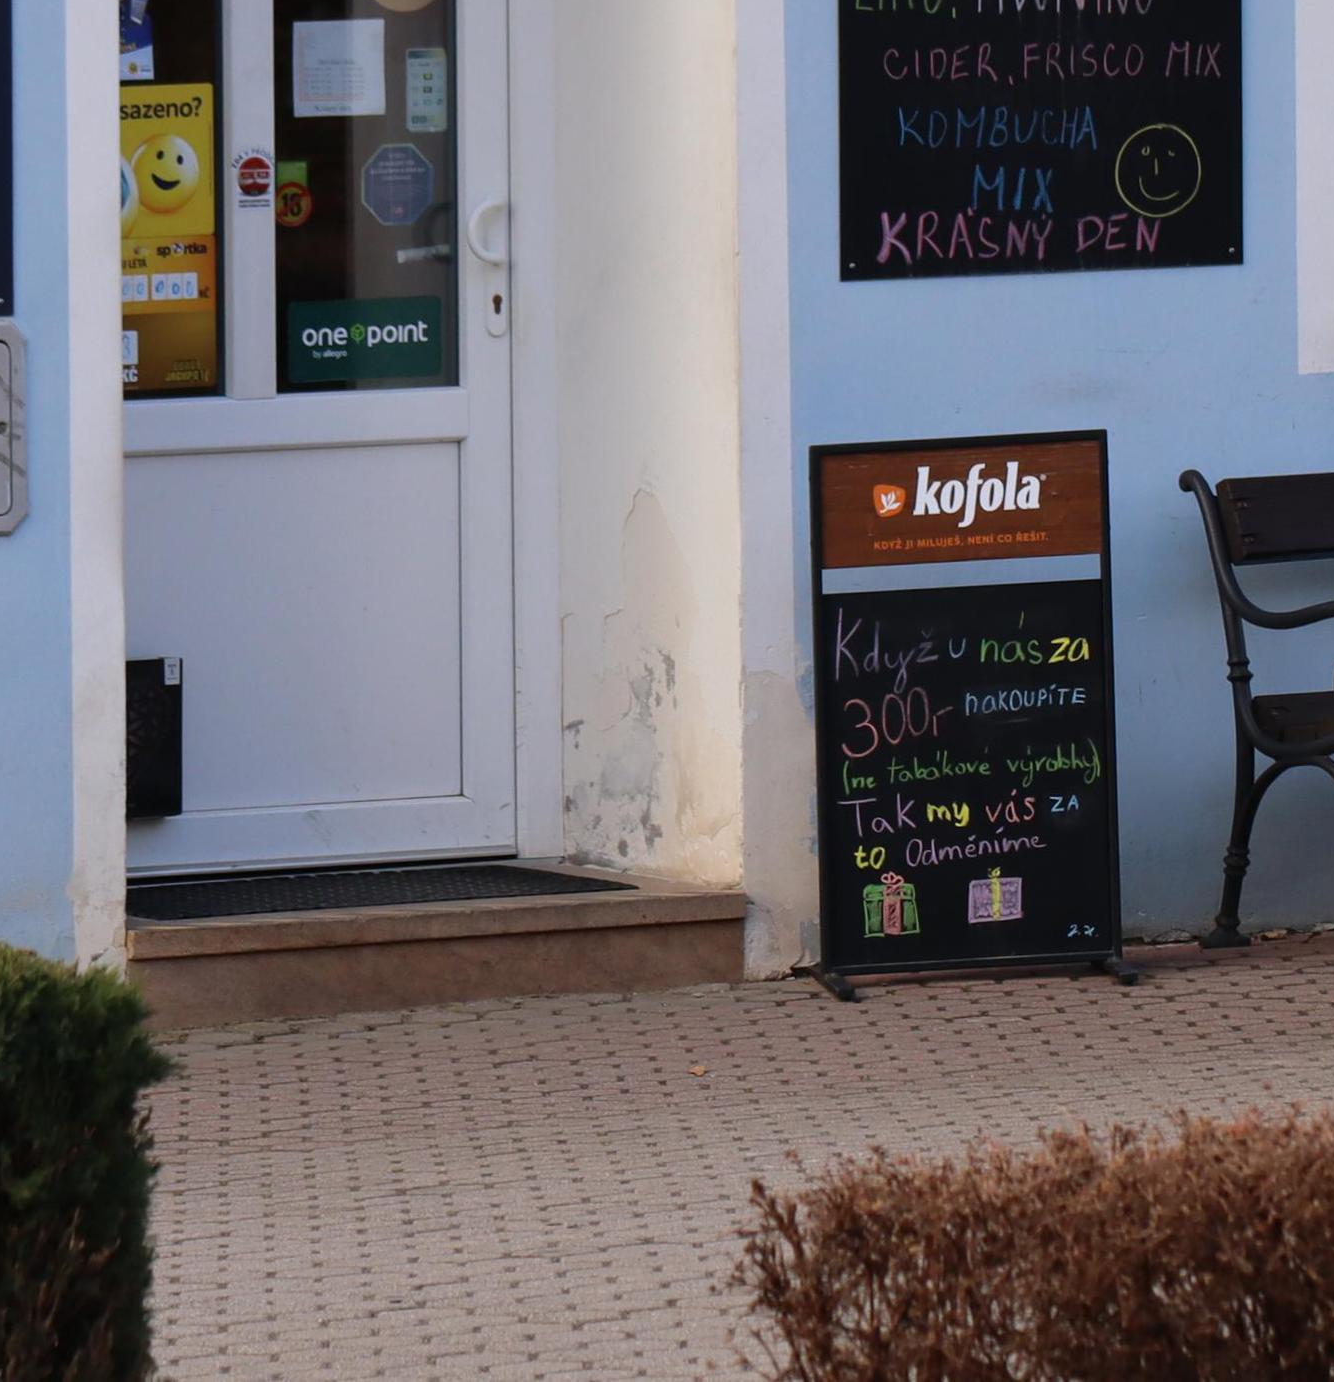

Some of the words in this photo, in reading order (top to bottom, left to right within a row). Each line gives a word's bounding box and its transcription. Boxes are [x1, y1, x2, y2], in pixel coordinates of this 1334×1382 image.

[1022, 42, 1144, 80] FRISCO
[1165, 41, 1222, 78] MIX
[898, 106, 1097, 150] KOMBUCHA
[971, 164, 1053, 212] MIX
[876, 207, 1052, 265] KRÁSNÝ
[1076, 213, 1161, 252] DEN
[302, 328, 347, 347] one
[367, 321, 428, 347] point
[913, 461, 1040, 528] kofola
[874, 538, 903, 551] KDYŽ
[905, 538, 914, 550] JI
[967, 533, 994, 546] NENÍ
[997, 534, 1013, 543] CO
[834, 608, 938, 692] Když
[979, 612, 1043, 665] nás
[1047, 634, 1090, 665] za
[887, 747, 991, 783] tabákové
[837, 794, 917, 837] Tak
[926, 800, 970, 826] my
[985, 790, 1036, 825] vás
[853, 843, 886, 870] to
